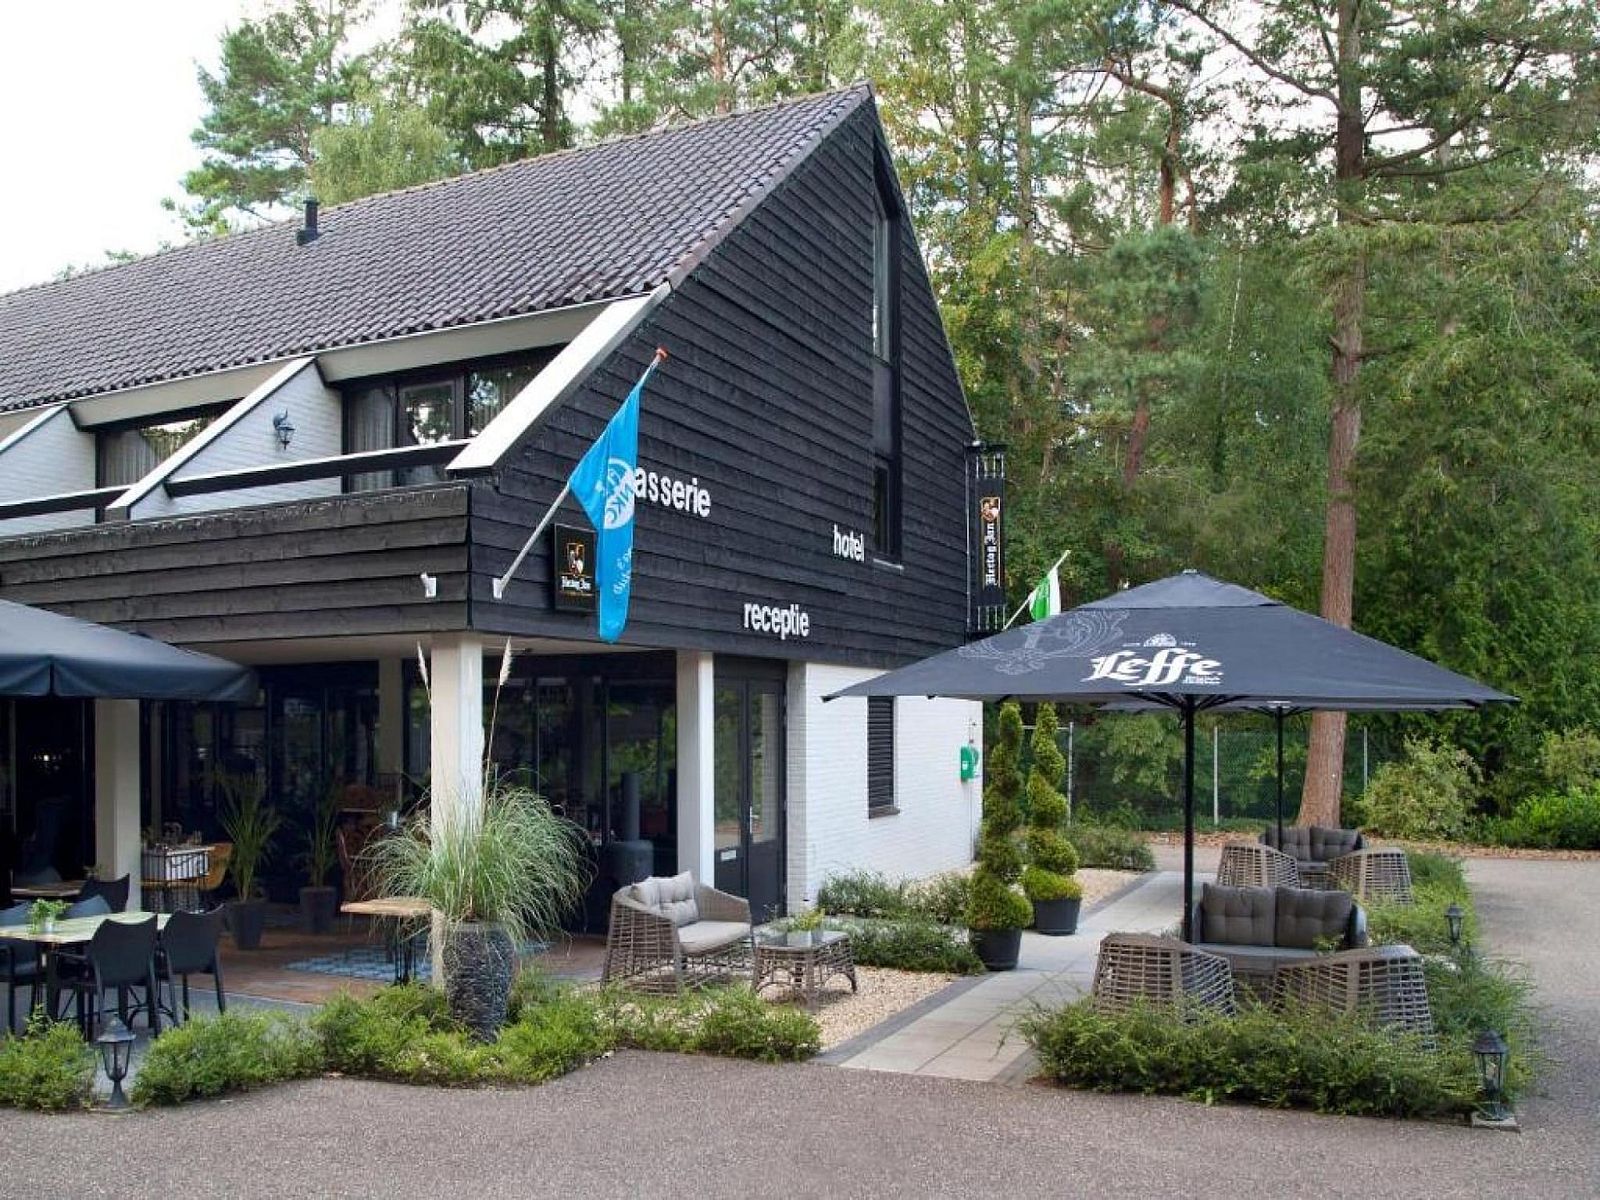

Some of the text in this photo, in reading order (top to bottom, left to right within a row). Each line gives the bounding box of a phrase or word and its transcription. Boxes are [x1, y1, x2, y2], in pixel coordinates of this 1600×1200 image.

[634, 466, 712, 518] asserie
[833, 523, 865, 563] hotel
[743, 602, 810, 640] receptie
[1080, 647, 1224, 686] Leffe
